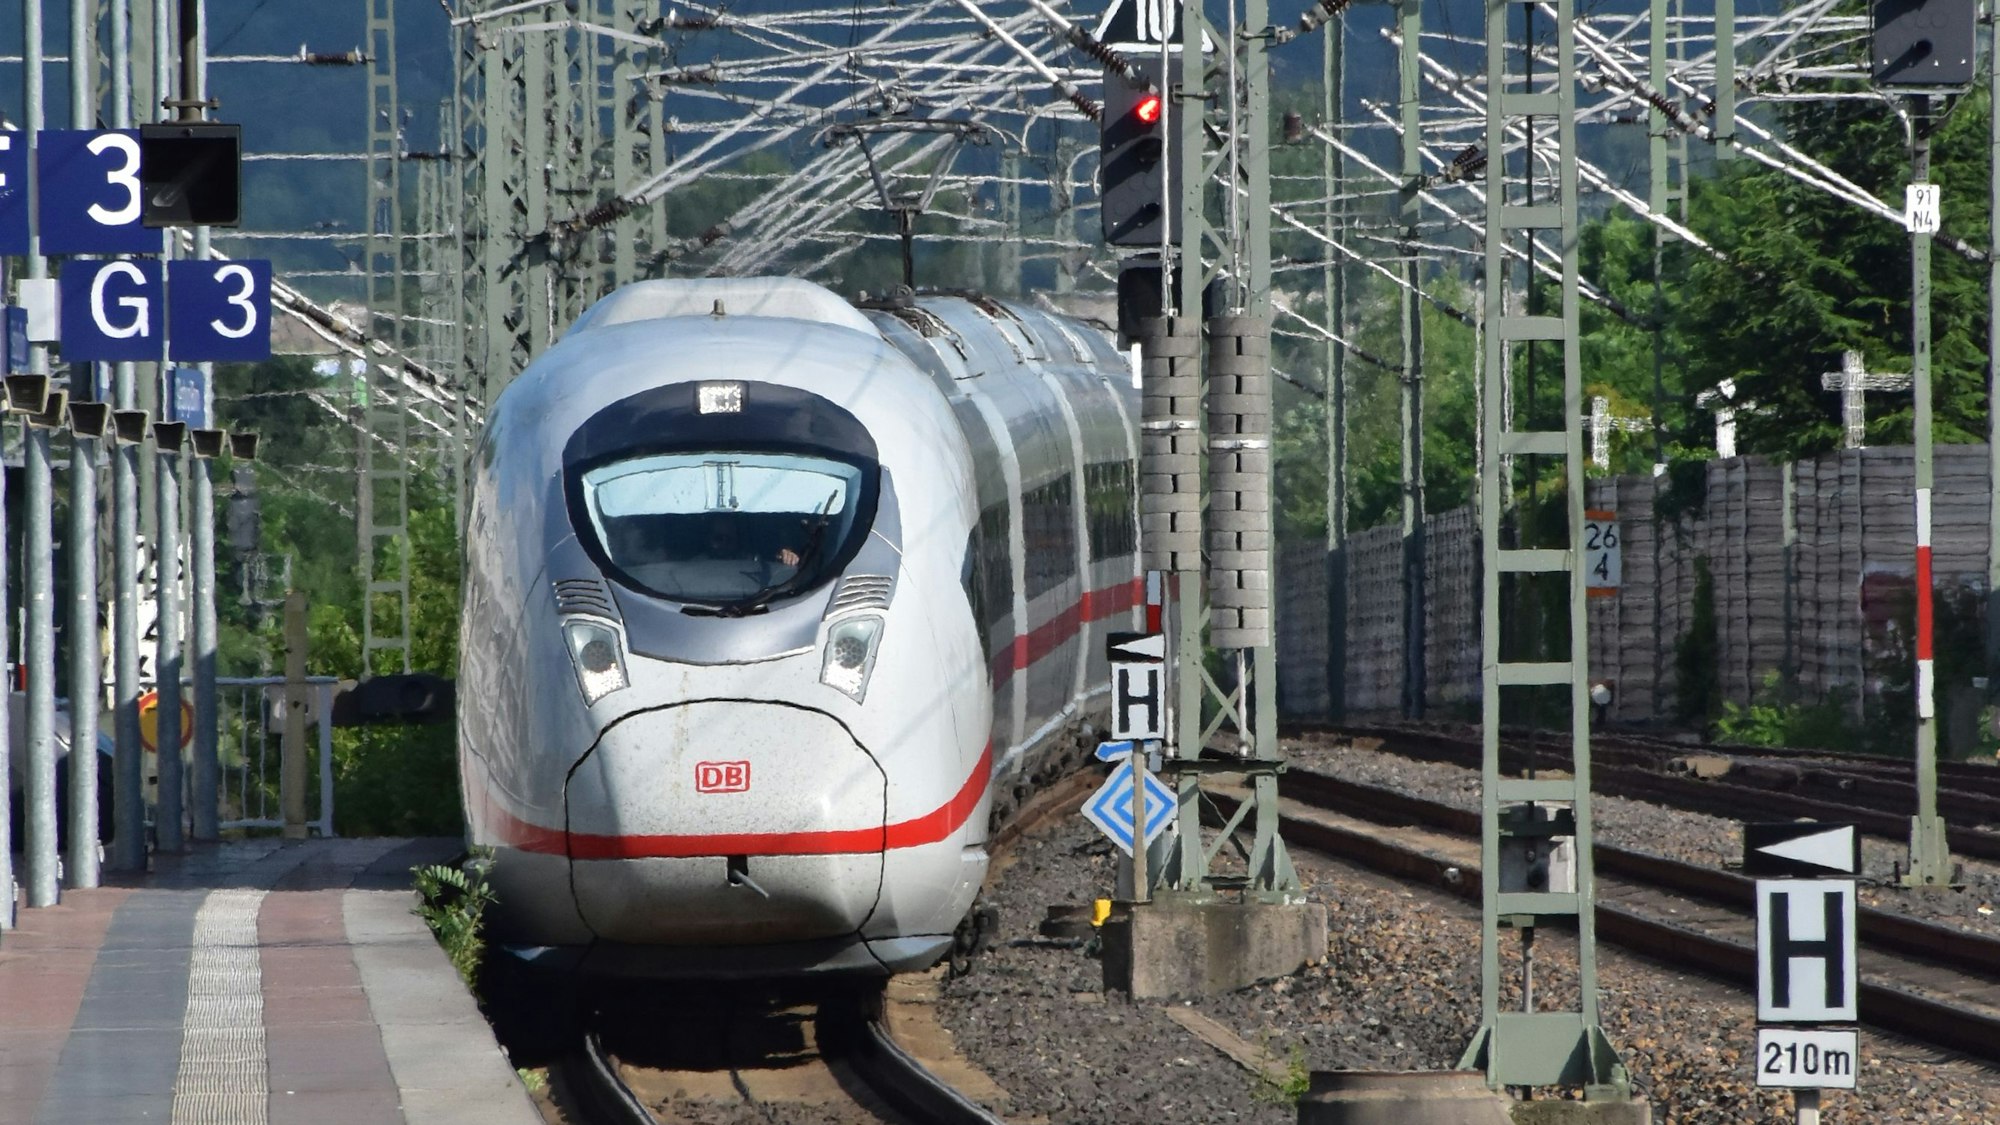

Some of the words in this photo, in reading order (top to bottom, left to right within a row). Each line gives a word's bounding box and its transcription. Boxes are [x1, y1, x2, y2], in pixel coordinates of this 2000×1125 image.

[86, 133, 141, 226] 3
[1916, 189, 1931, 205] 91
[1913, 210, 1933, 231] N4
[90, 261, 149, 339] G
[210, 264, 257, 339] 3
[1585, 522, 1617, 550] 26
[1592, 552, 1608, 581] 4
[1118, 668, 1158, 733] H
[701, 765, 743, 788] DB
[1770, 892, 1844, 1009] H
[1764, 1042, 1850, 1076] 210m
